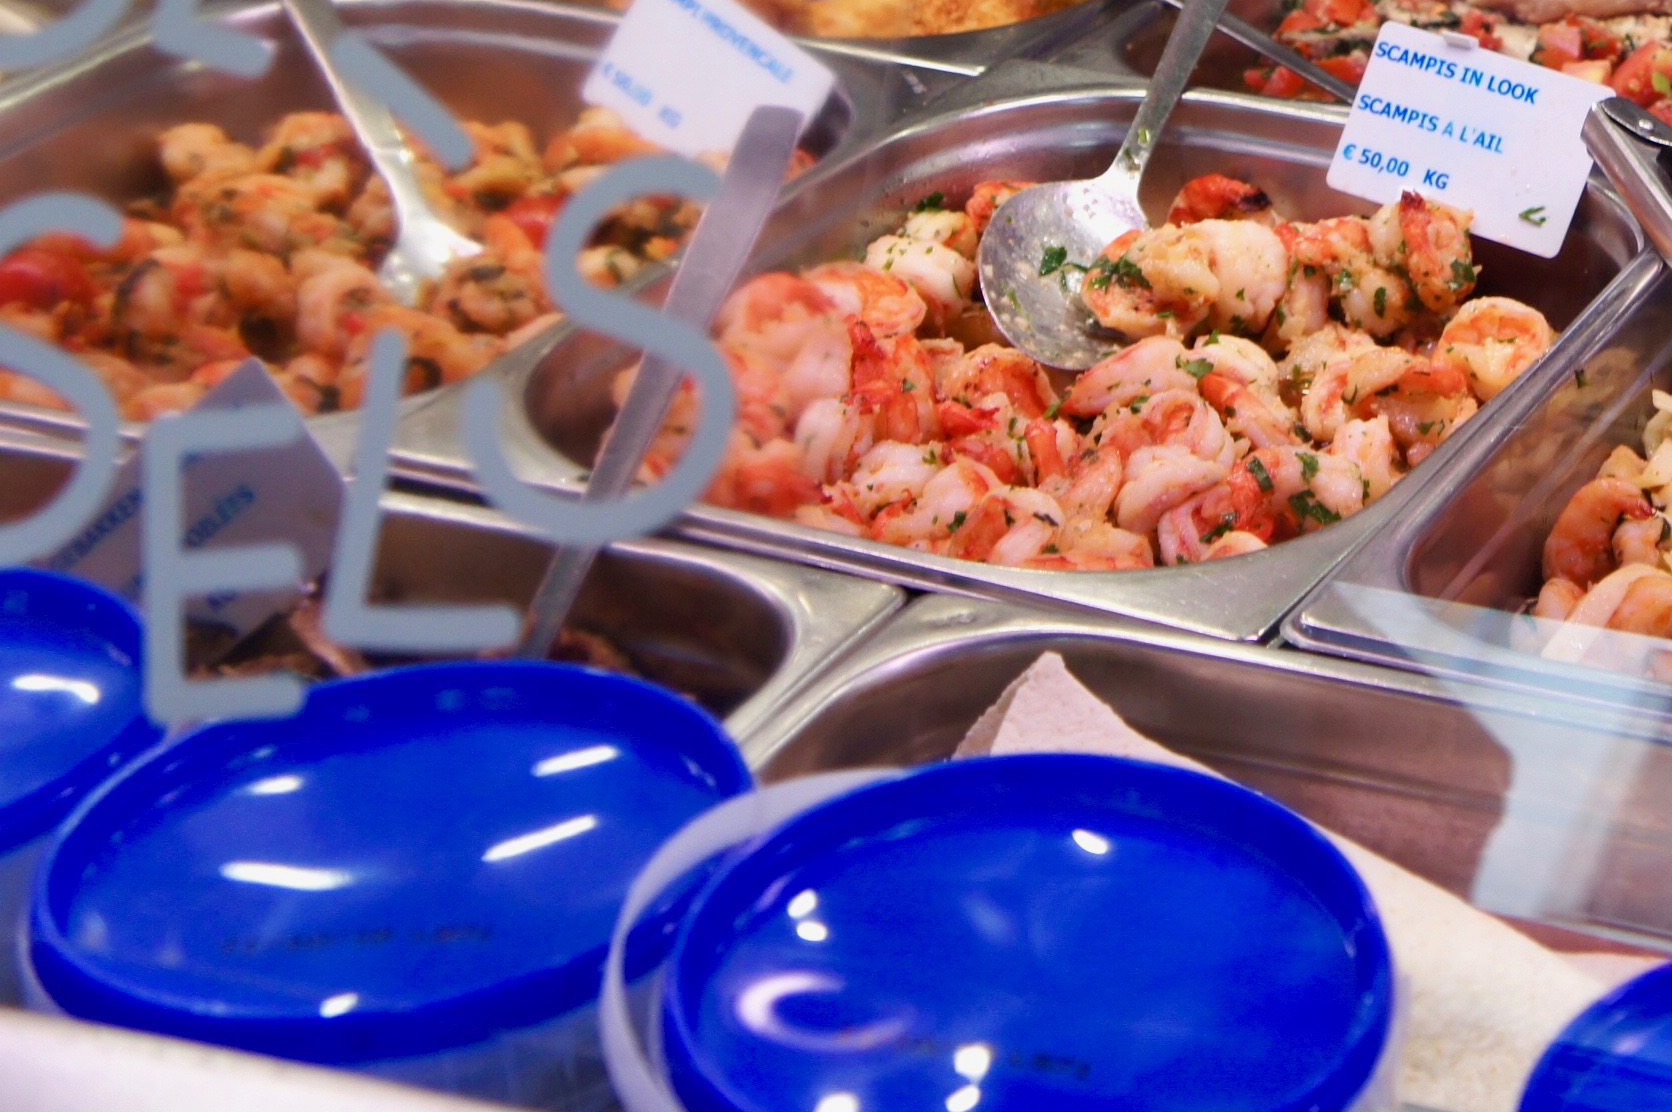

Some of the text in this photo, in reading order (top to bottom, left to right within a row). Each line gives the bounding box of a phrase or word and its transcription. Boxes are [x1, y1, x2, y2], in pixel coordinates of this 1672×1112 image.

[1375, 41, 1540, 105] SCAMPIS IN LOOK
[1357, 94, 1438, 133] SCAMPIS
[1459, 125, 1504, 154] L'AIL
[1343, 143, 1450, 190] € 50,00 KG
